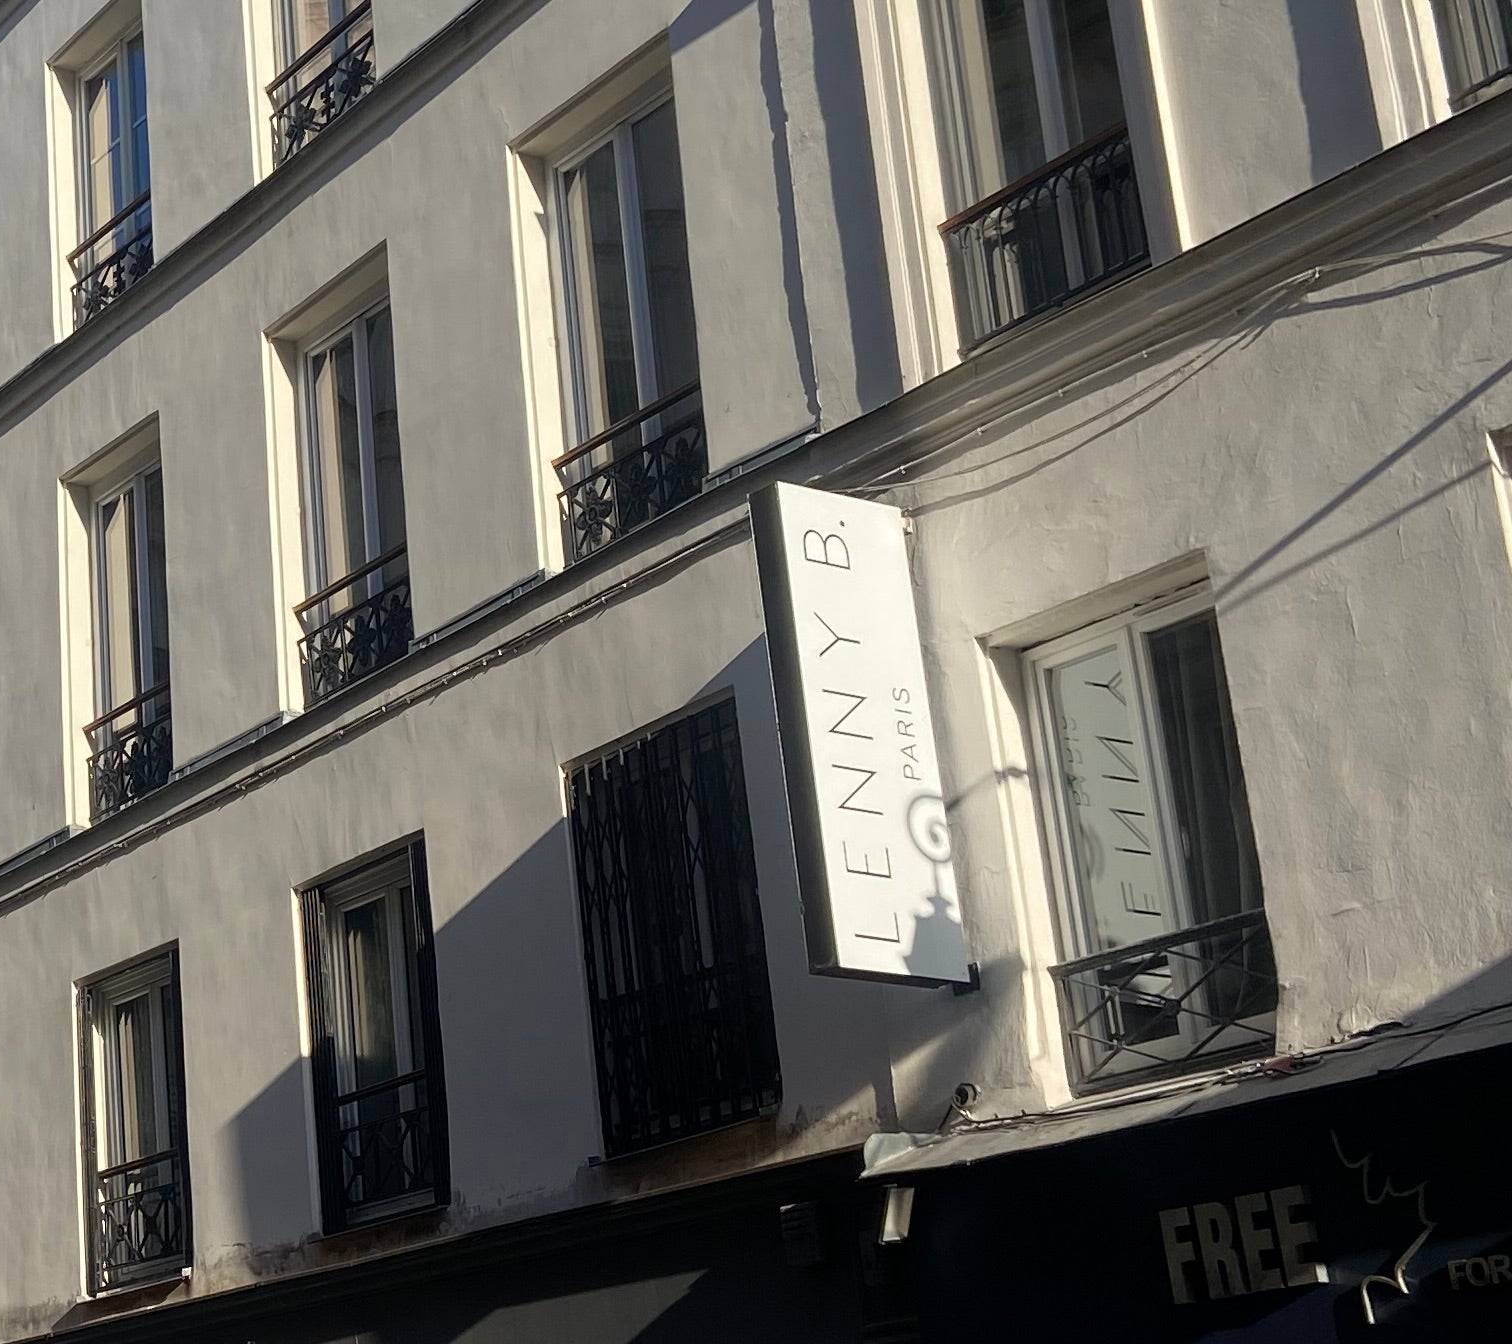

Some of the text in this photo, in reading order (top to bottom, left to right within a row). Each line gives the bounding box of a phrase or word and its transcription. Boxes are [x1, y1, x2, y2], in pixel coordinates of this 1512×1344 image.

[802, 519, 901, 944] LENNY B.
[891, 686, 921, 782] PARIS
[1158, 1184, 1329, 1305] FREE
